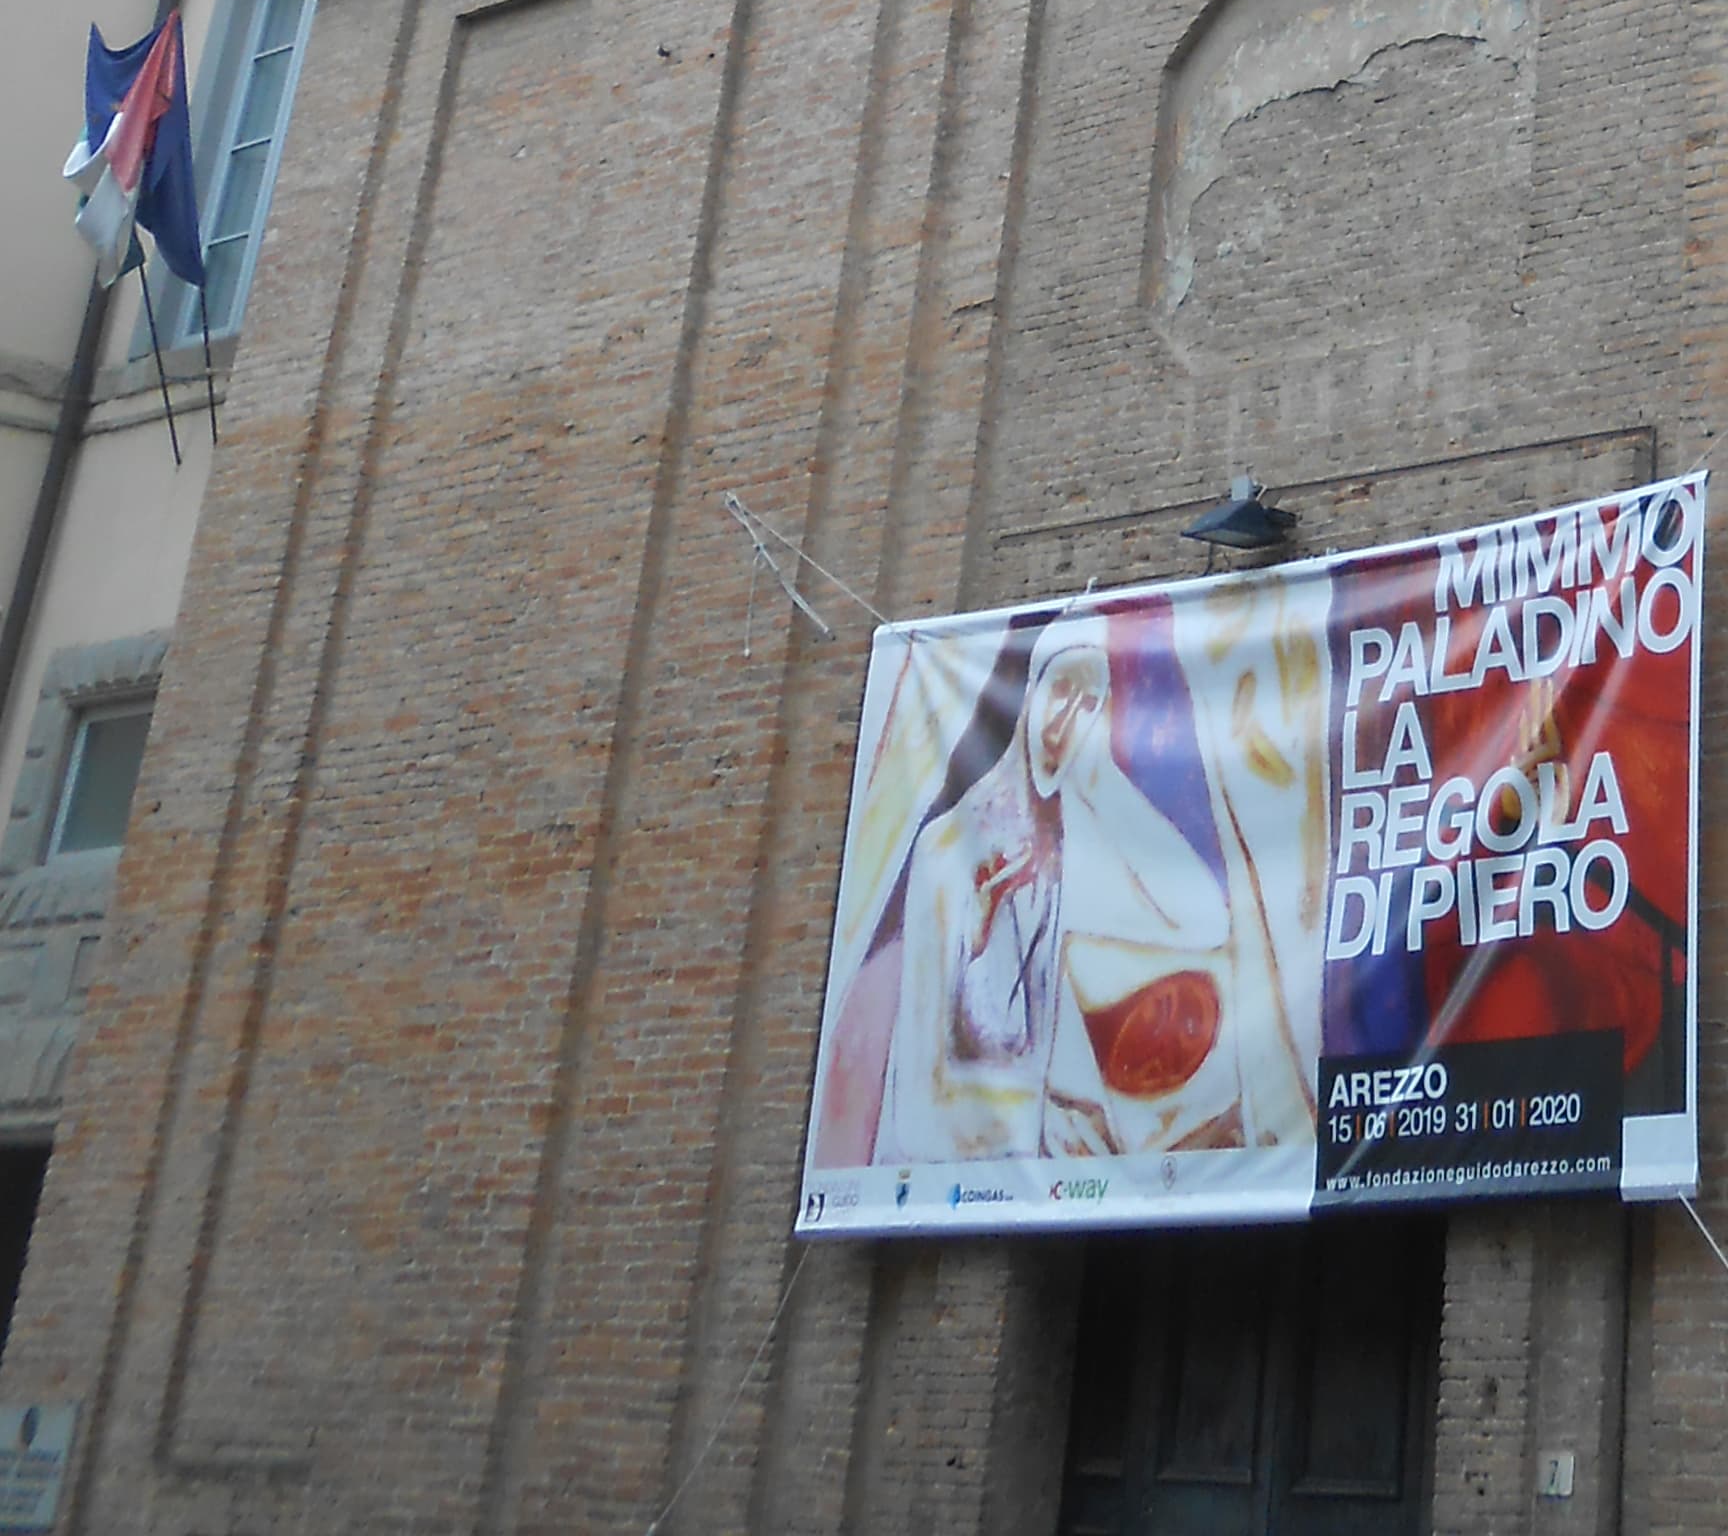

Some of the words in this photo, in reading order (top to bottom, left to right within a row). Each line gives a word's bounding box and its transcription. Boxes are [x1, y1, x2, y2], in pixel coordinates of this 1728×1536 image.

[1435, 484, 1698, 612] MIMMO
[1346, 567, 1693, 707] PALADINO
[1342, 702, 1432, 790] LA
[1336, 751, 1629, 874] REGOLA
[1326, 872, 1394, 960] DI
[1406, 839, 1629, 952] PIERO
[1329, 1063, 1447, 1108] AREZZO
[1326, 1156, 1611, 1191] www.fondazioneguidodarezzo.com
